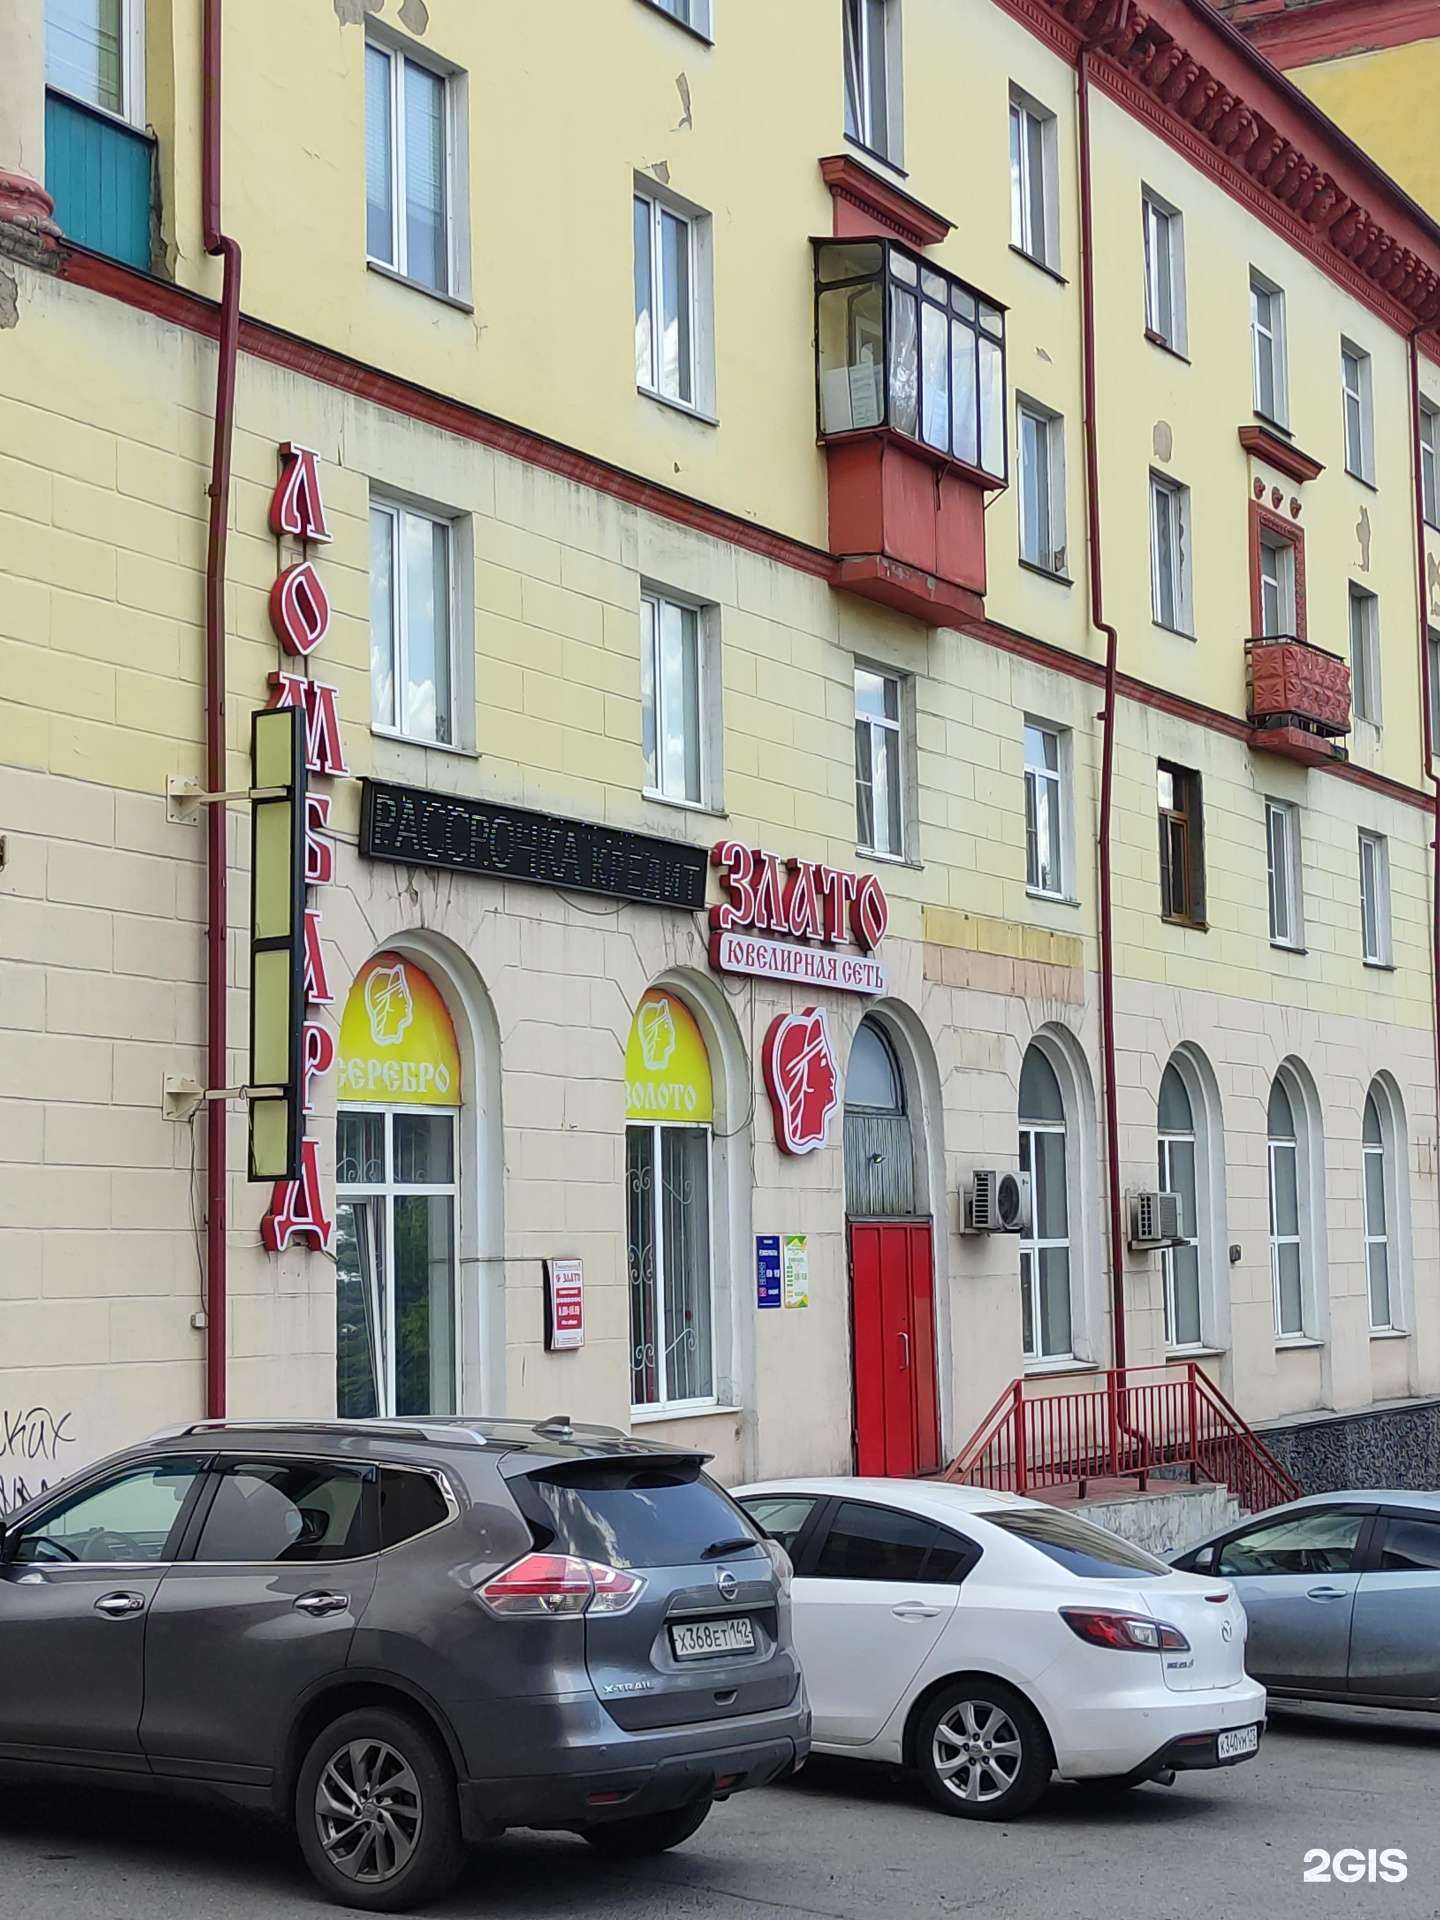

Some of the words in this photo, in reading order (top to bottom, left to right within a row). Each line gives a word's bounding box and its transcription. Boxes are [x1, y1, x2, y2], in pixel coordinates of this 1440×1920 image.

[711, 840, 889, 950] ЗЛАТО
[727, 939, 838, 981] ЮВЕЛИРНАЯ
[842, 960, 883, 989] СЕТЬ
[603, 1680, 656, 1694] X-TRAIL
